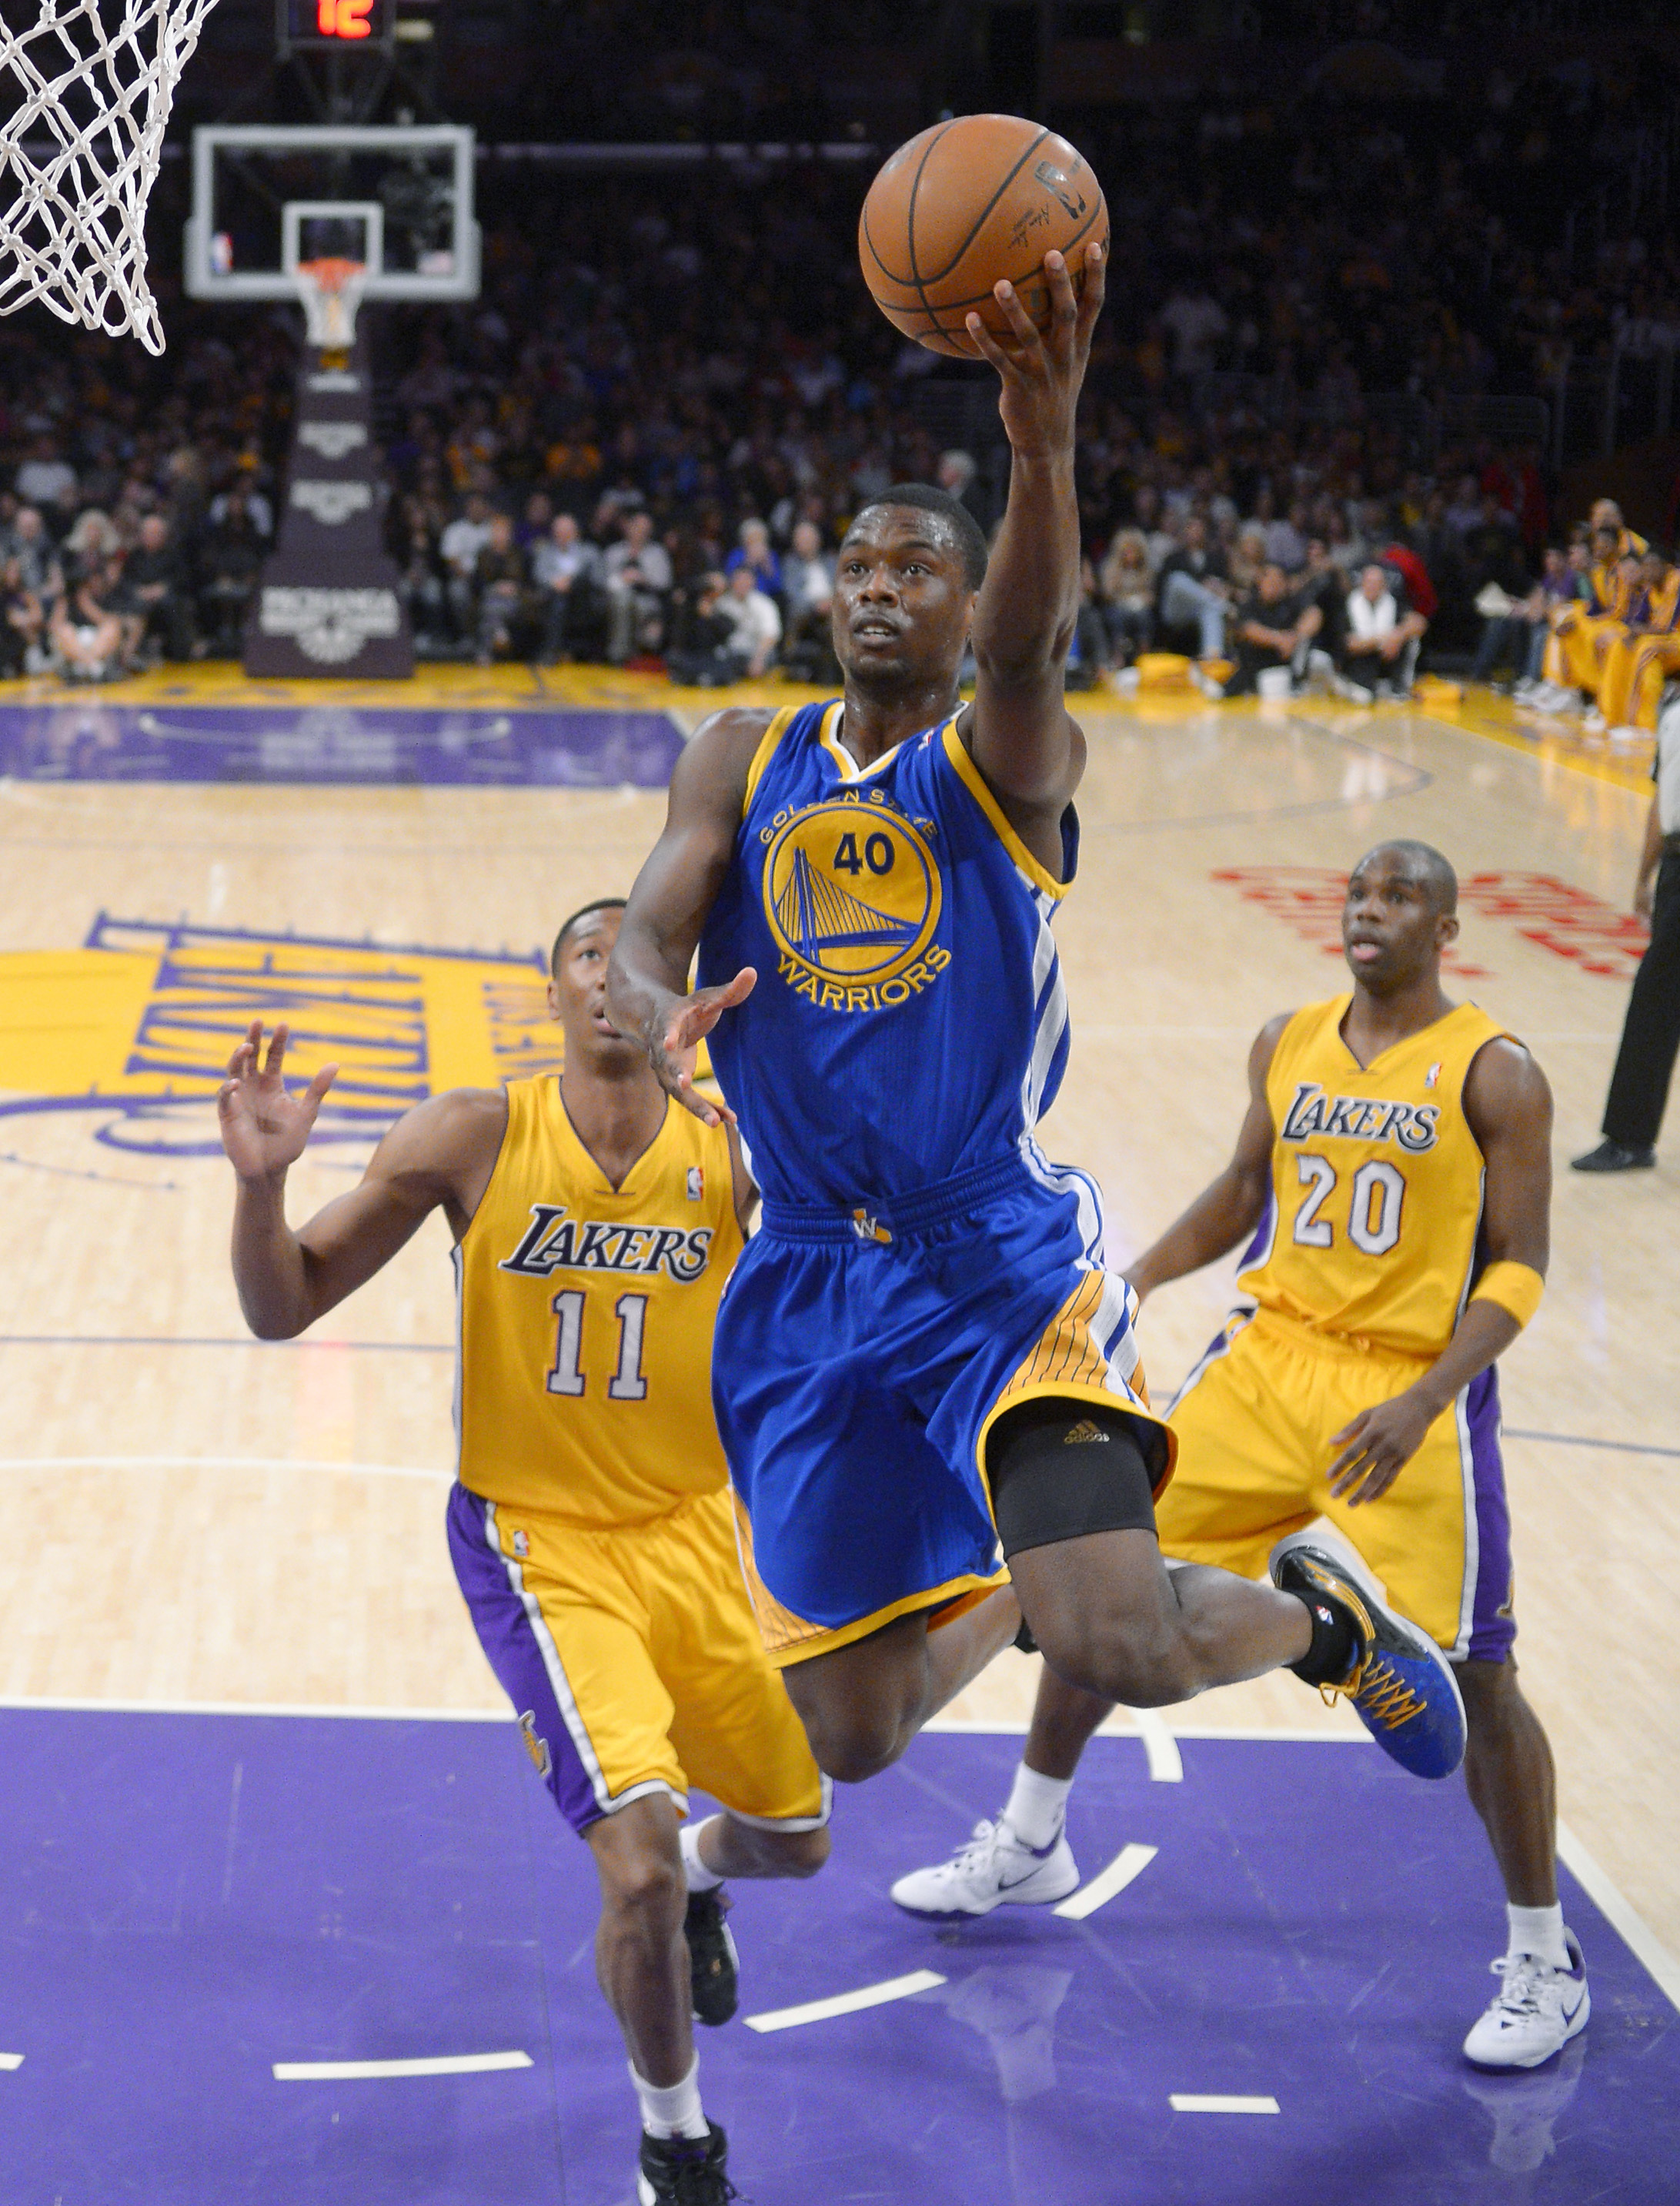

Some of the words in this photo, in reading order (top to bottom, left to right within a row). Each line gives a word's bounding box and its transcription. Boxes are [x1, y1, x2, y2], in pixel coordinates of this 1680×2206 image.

[759, 787, 860, 845] GOLN
[833, 832, 895, 876] 40
[777, 944, 953, 1012] WARRIORS
[1281, 1081, 1441, 1156] LAKERS
[1293, 1152, 1406, 1256] 20
[496, 1203, 715, 1285] LAKERS
[546, 1289, 649, 1401] 11
[1064, 1430, 1111, 1445] adidas
